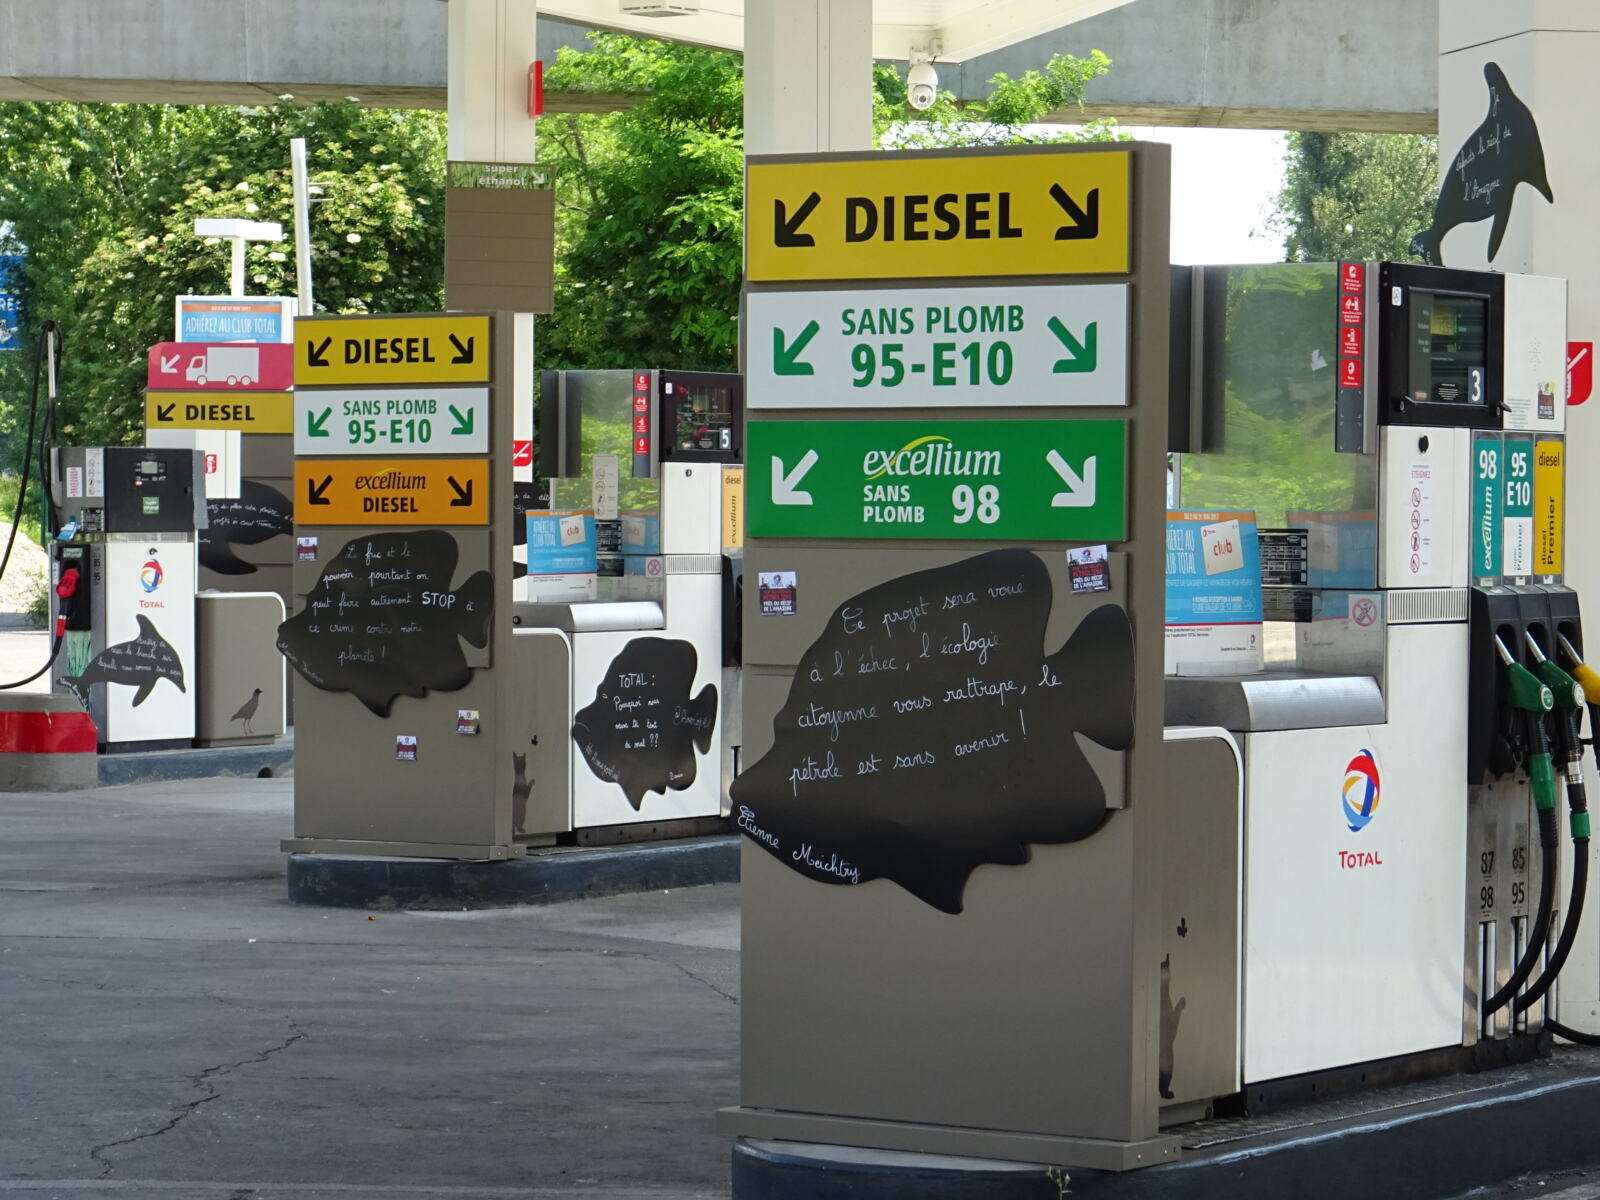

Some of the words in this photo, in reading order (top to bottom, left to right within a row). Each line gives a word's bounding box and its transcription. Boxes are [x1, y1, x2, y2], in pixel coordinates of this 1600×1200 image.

[485, 165, 518, 174] super
[845, 191, 1023, 243] DIESEL
[254, 318, 275, 333] TOTAL
[841, 307, 914, 335] SANS
[926, 304, 1024, 334] PLOMB
[344, 337, 435, 364] DIESEL
[851, 340, 1013, 387] 95-E10
[1472, 369, 1480, 401] 3
[185, 404, 255, 421] DIESEL
[343, 400, 381, 416] SANS
[387, 399, 437, 415] PLOMB
[348, 418, 432, 444] 95-E10
[722, 429, 729, 448] 5
[863, 441, 1001, 477] excellium
[1479, 449, 1497, 480] 98
[1511, 452, 1526, 477] 95
[1538, 451, 1560, 467] diesel
[355, 471, 426, 490] excellium
[863, 484, 911, 502] SANS
[951, 484, 1001, 525] 98
[1507, 481, 1530, 506] E10
[363, 497, 418, 513] DIESEL
[863, 504, 925, 524] PLOMB
[1484, 486, 1493, 570] excellium
[365, 542, 382, 566] fric
[1213, 538, 1233, 556] club
[322, 569, 355, 589] pouvoir
[368, 569, 411, 588] pourtant
[416, 573, 429, 581] on
[138, 600, 166, 609] TOTAL
[311, 598, 330, 616] peut
[338, 592, 360, 616] faire
[370, 594, 413, 606] autrement
[421, 591, 456, 609] STOP
[881, 595, 930, 639] projet
[941, 590, 977, 610] sera
[987, 575, 1025, 598] voué
[308, 625, 320, 633] ce
[338, 645, 375, 666] planète
[618, 672, 649, 689] TOTAL
[809, 661, 823, 682] à
[613, 695, 642, 713] Pourquoi
[798, 702, 878, 742] citoyenne
[893, 695, 932, 714] vous
[943, 677, 1026, 706] rattrape,
[1038, 664, 1063, 687] le
[789, 750, 843, 797] pétrole
[857, 753, 882, 775] est
[893, 751, 936, 770] sans
[954, 729, 1009, 757] avenir
[1019, 708, 1027, 741] !
[737, 805, 780, 849] Étienne
[1338, 851, 1383, 869] TOTAL
[1480, 851, 1495, 875] 87
[1512, 847, 1526, 870] 85
[1480, 886, 1494, 909] 98
[1511, 881, 1525, 905] 95
